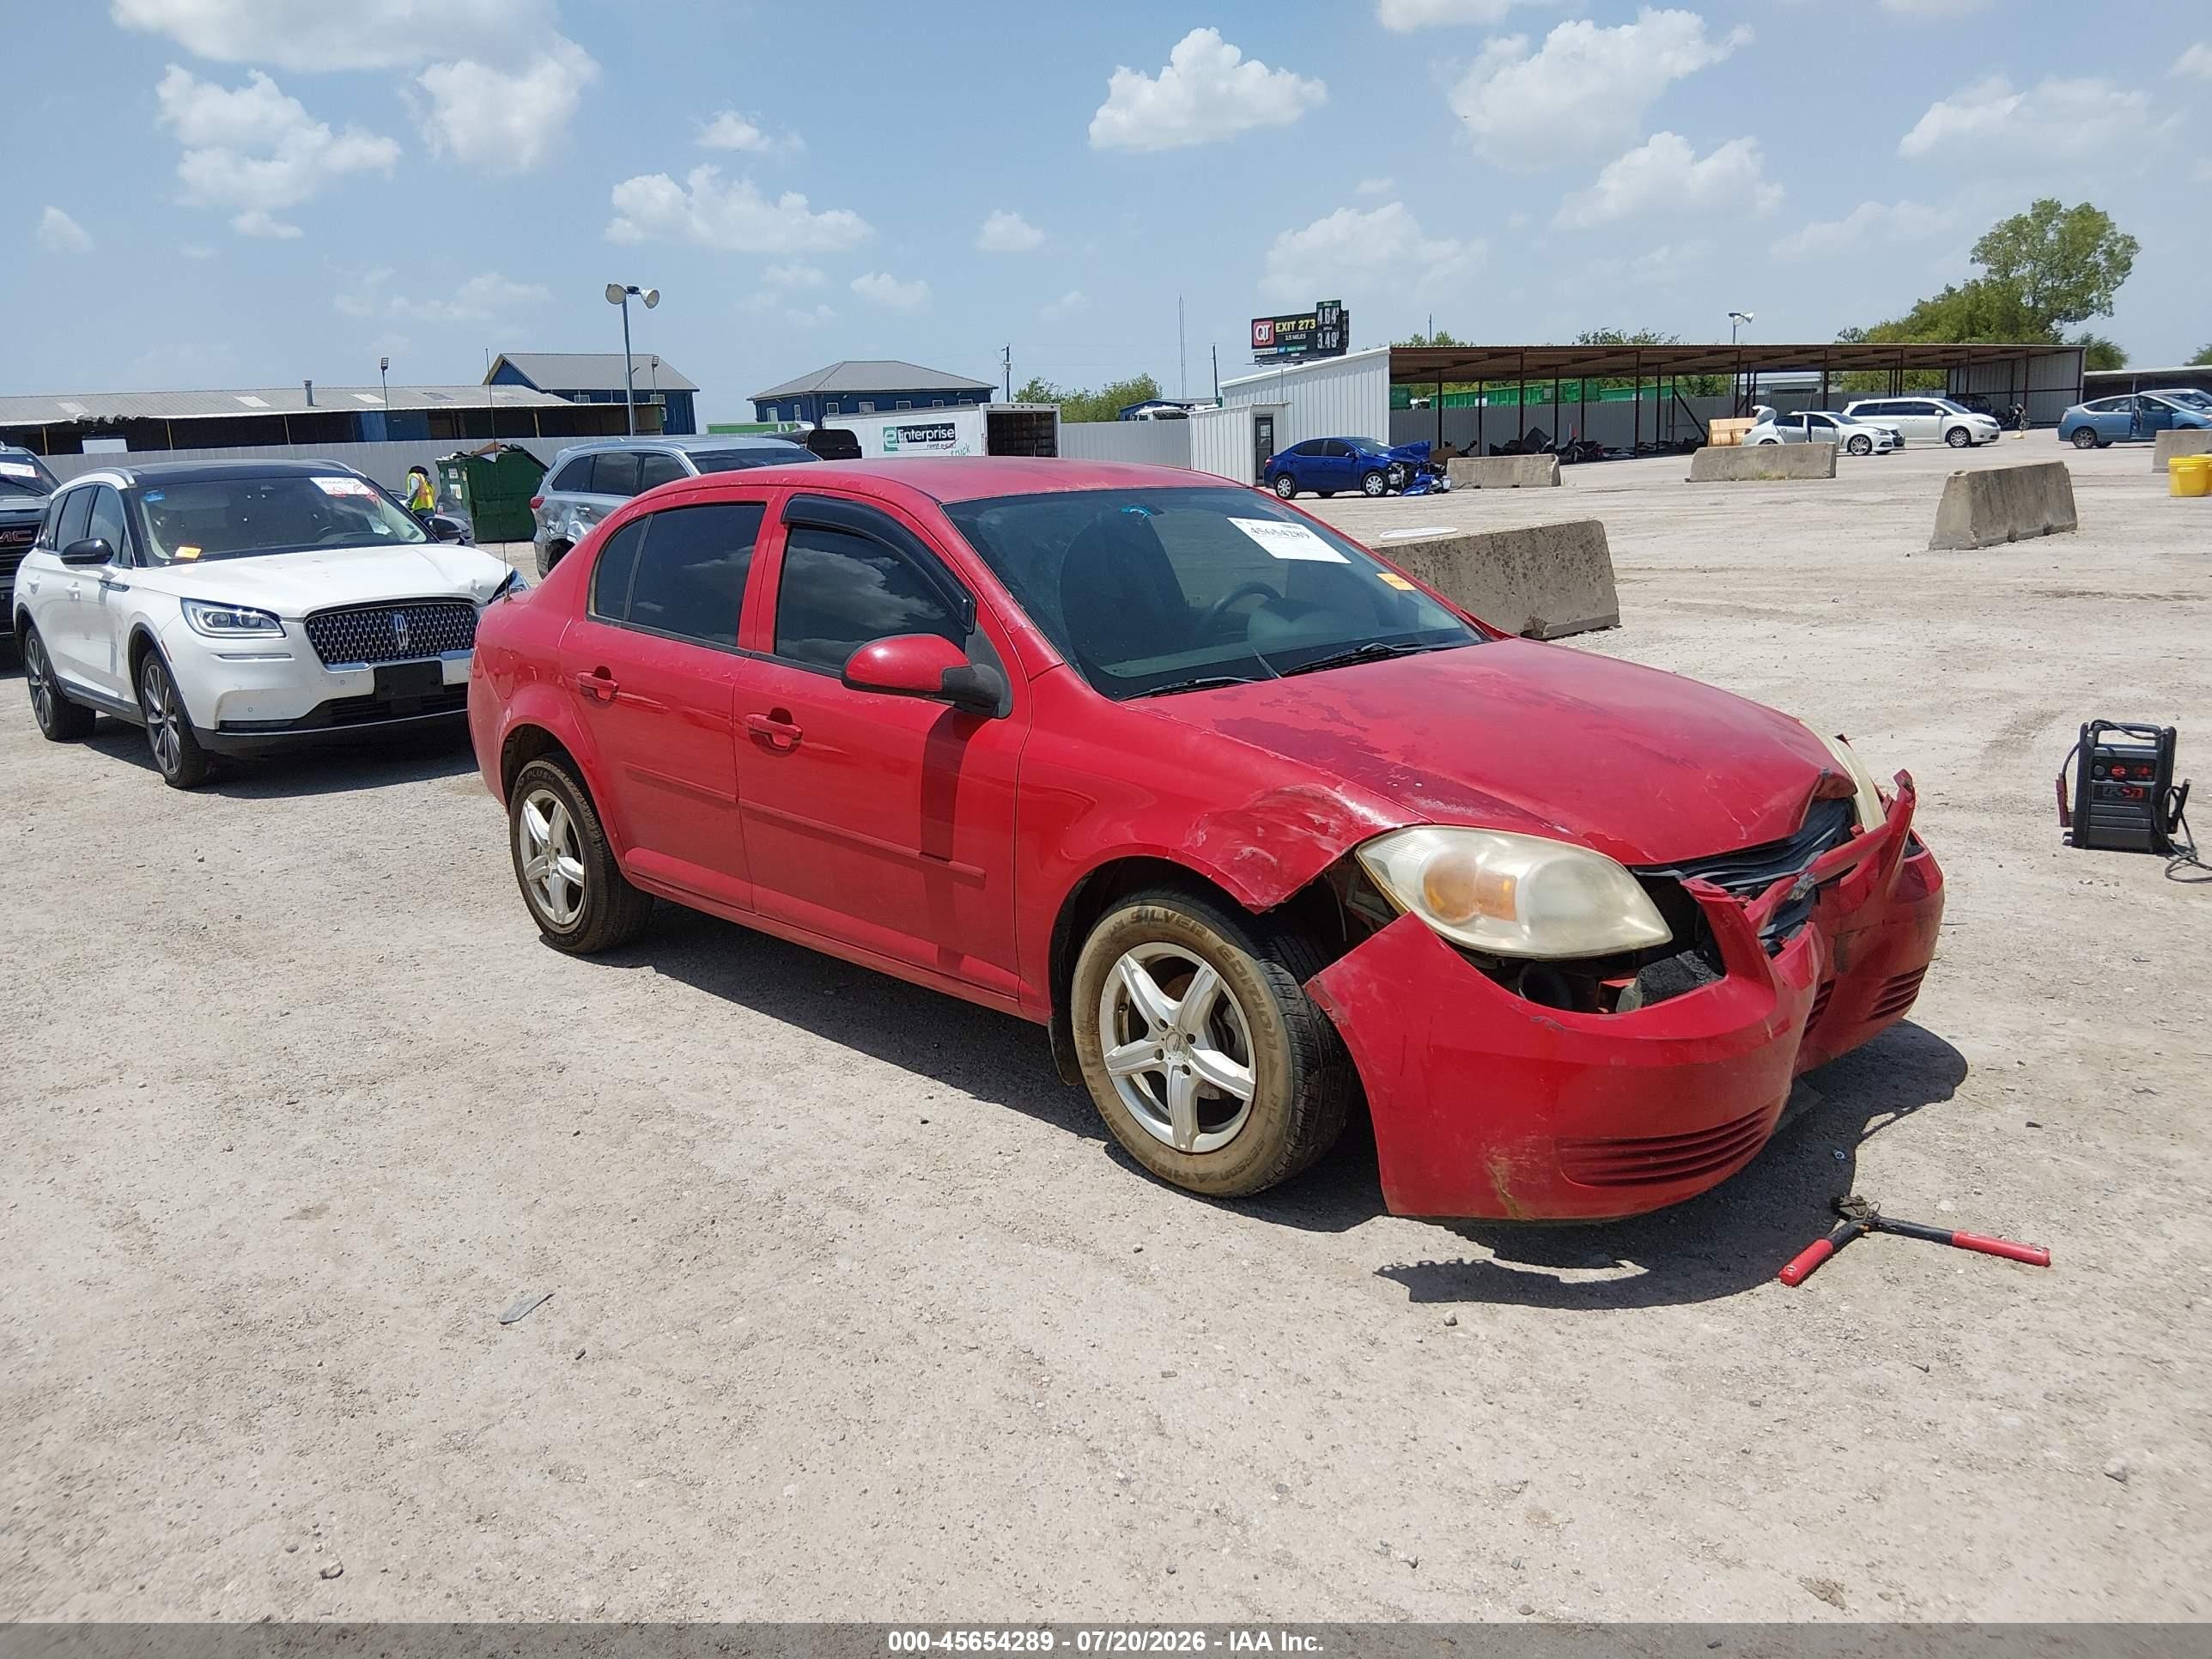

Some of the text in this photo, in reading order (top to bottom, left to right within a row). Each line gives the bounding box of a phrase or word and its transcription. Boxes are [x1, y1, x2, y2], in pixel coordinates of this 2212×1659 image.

[1255, 325, 1271, 342] QT
[1275, 322, 1296, 332] EXIT
[1298, 319, 1316, 330] 273
[898, 426, 954, 441] Enterprise
[1130, 908, 1279, 1050] SILVER EDITION
